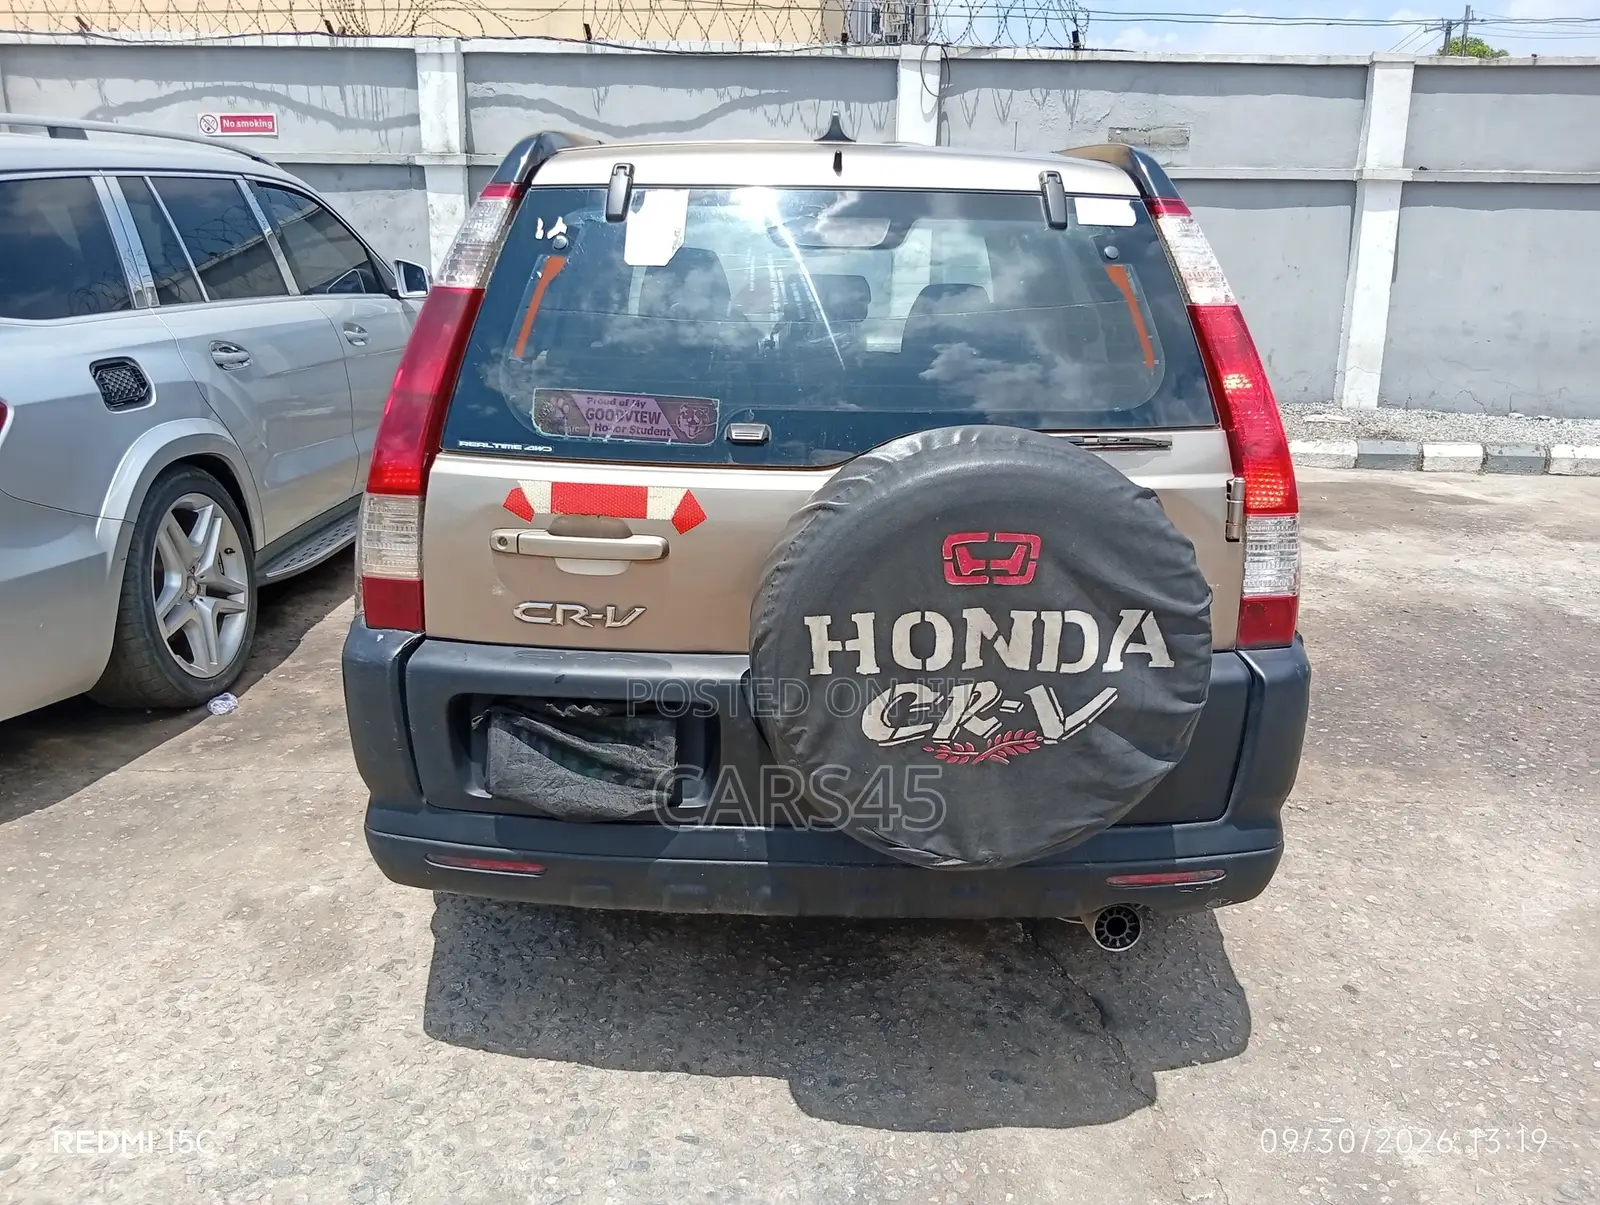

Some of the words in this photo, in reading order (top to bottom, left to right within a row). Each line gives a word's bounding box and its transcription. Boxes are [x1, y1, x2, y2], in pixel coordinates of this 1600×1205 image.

[223, 119, 235, 128] No
[237, 119, 273, 129] smoking
[586, 397, 617, 406] Proud
[619, 398, 629, 407] of
[631, 400, 646, 409] My
[594, 422, 626, 434] Hoor
[629, 424, 672, 437] Student
[458, 440, 523, 451] REALTIME
[523, 444, 553, 453] 4WD
[512, 600, 648, 628] CR-V
[803, 607, 1175, 676] HONDA
[861, 681, 1119, 747] CR-V
